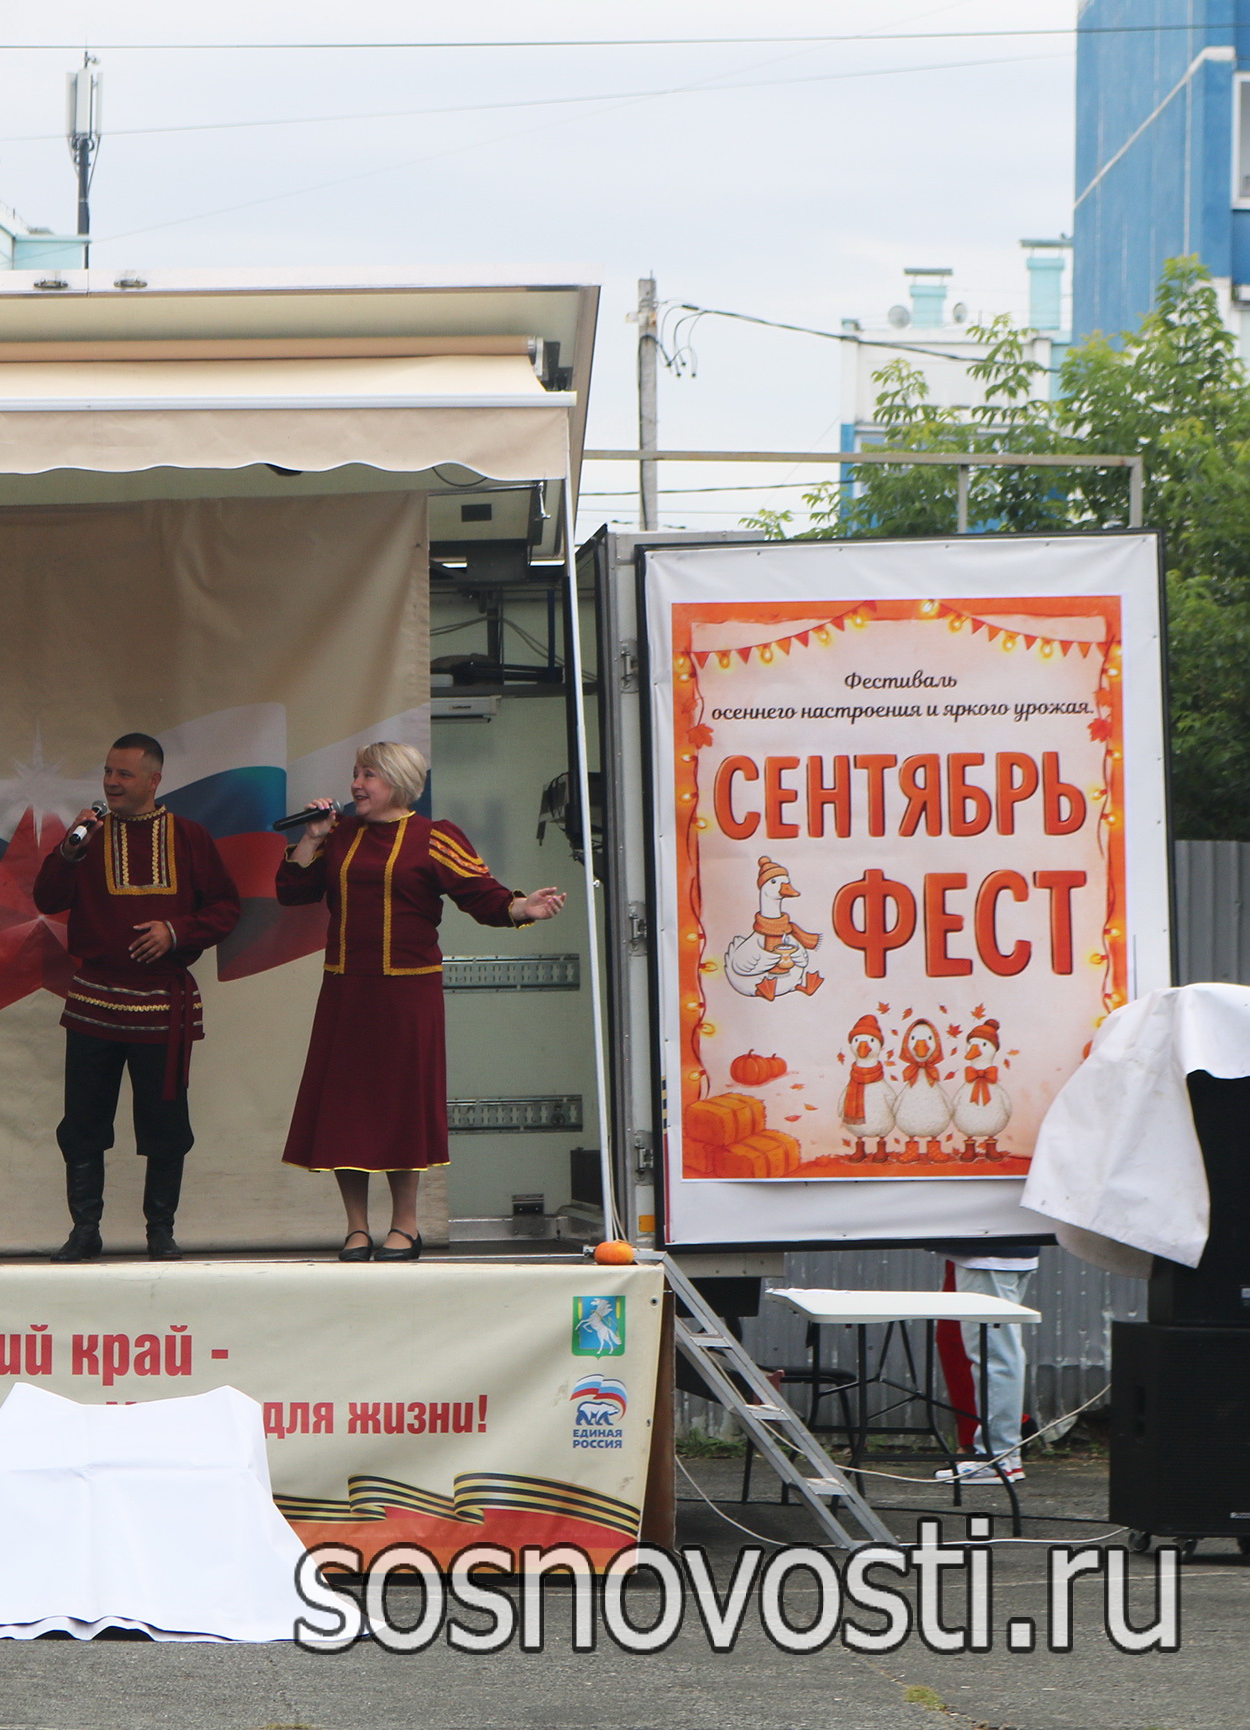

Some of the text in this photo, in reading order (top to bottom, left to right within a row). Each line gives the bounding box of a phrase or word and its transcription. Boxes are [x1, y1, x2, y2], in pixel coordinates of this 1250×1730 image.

[844, 670, 958, 690] Фестиваль
[711, 706, 797, 721] осеннего
[801, 703, 922, 724] настроения
[926, 704, 940, 719] и
[943, 703, 1010, 724] яркого
[713, 752, 1087, 841] СЕНТЯБРЬ
[831, 868, 1088, 979] ФЕСТ
[71, 1324, 193, 1387] край
[263, 1394, 489, 1440] для жизни!
[573, 1429, 623, 1438] ЕДИНАЯ
[573, 1439, 623, 1449] РОССИЯ
